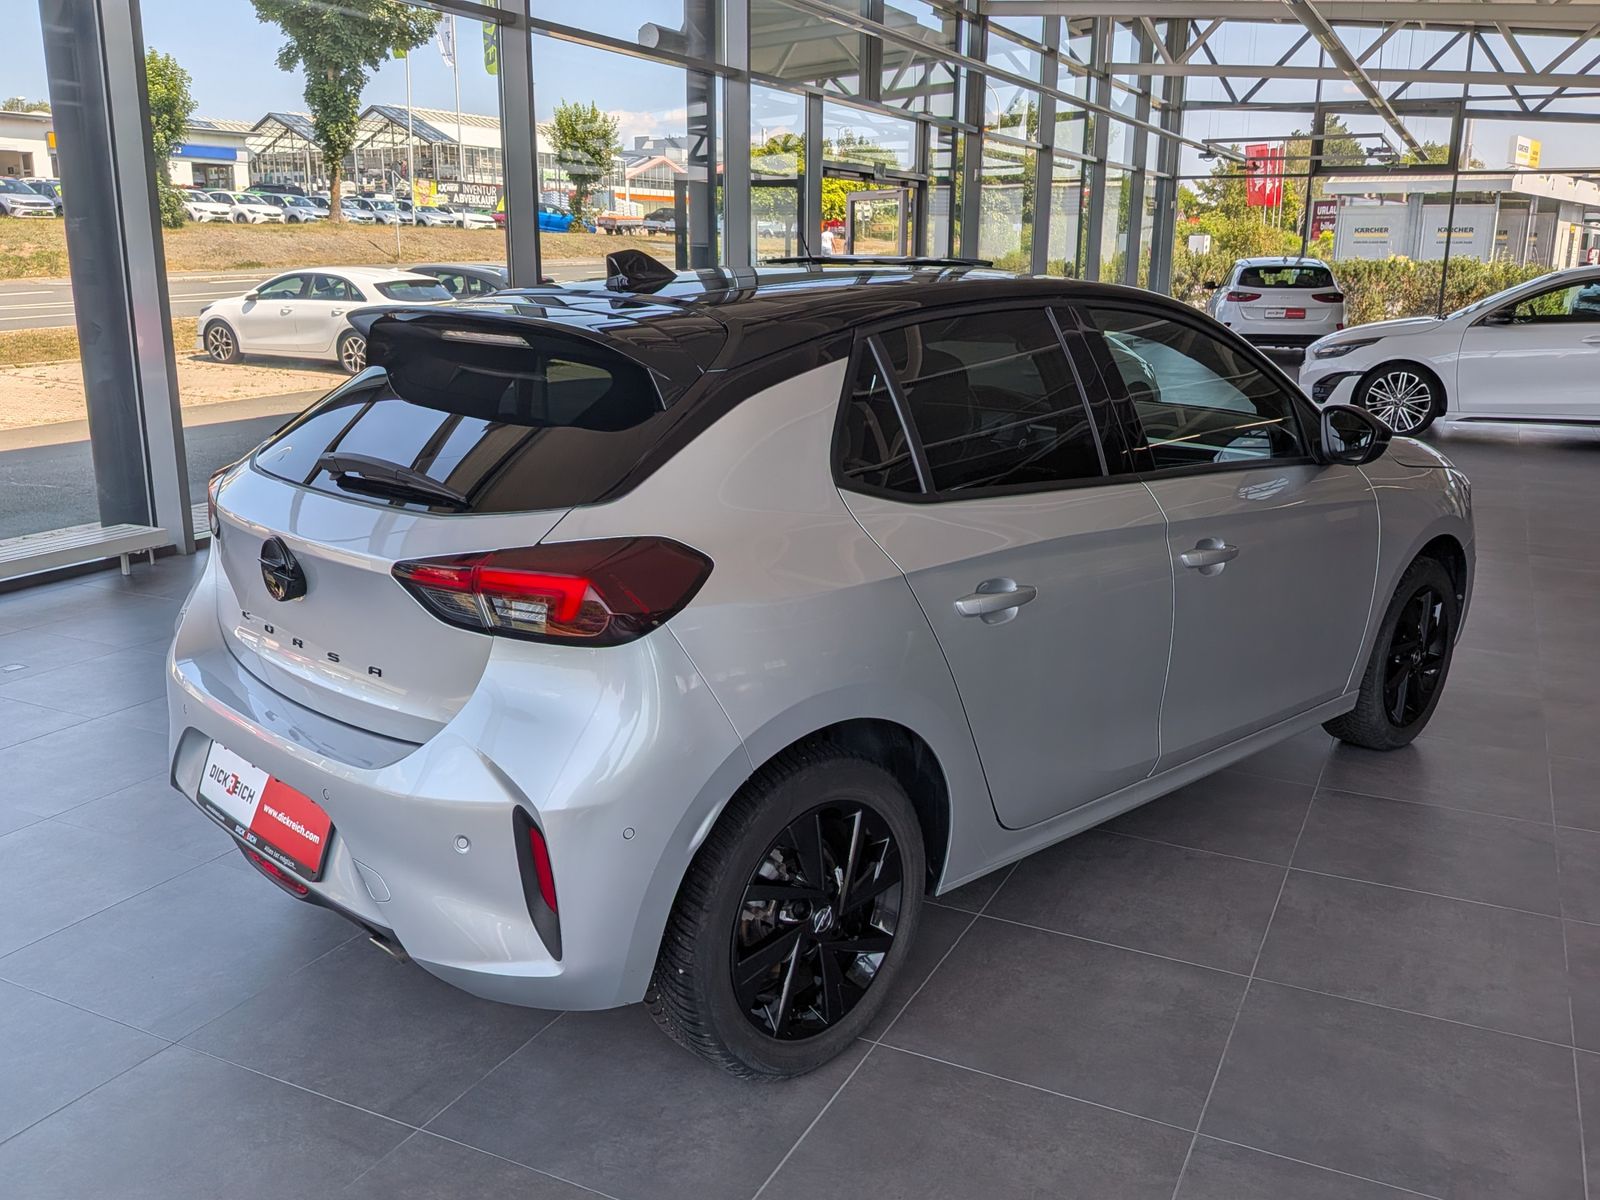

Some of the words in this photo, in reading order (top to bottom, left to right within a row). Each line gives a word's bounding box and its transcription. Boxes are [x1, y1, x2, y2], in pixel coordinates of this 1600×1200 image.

[462, 184, 497, 196] INVENTUR
[242, 610, 382, 677] CORSA
[263, 803, 320, 845] www.dickreich.com
